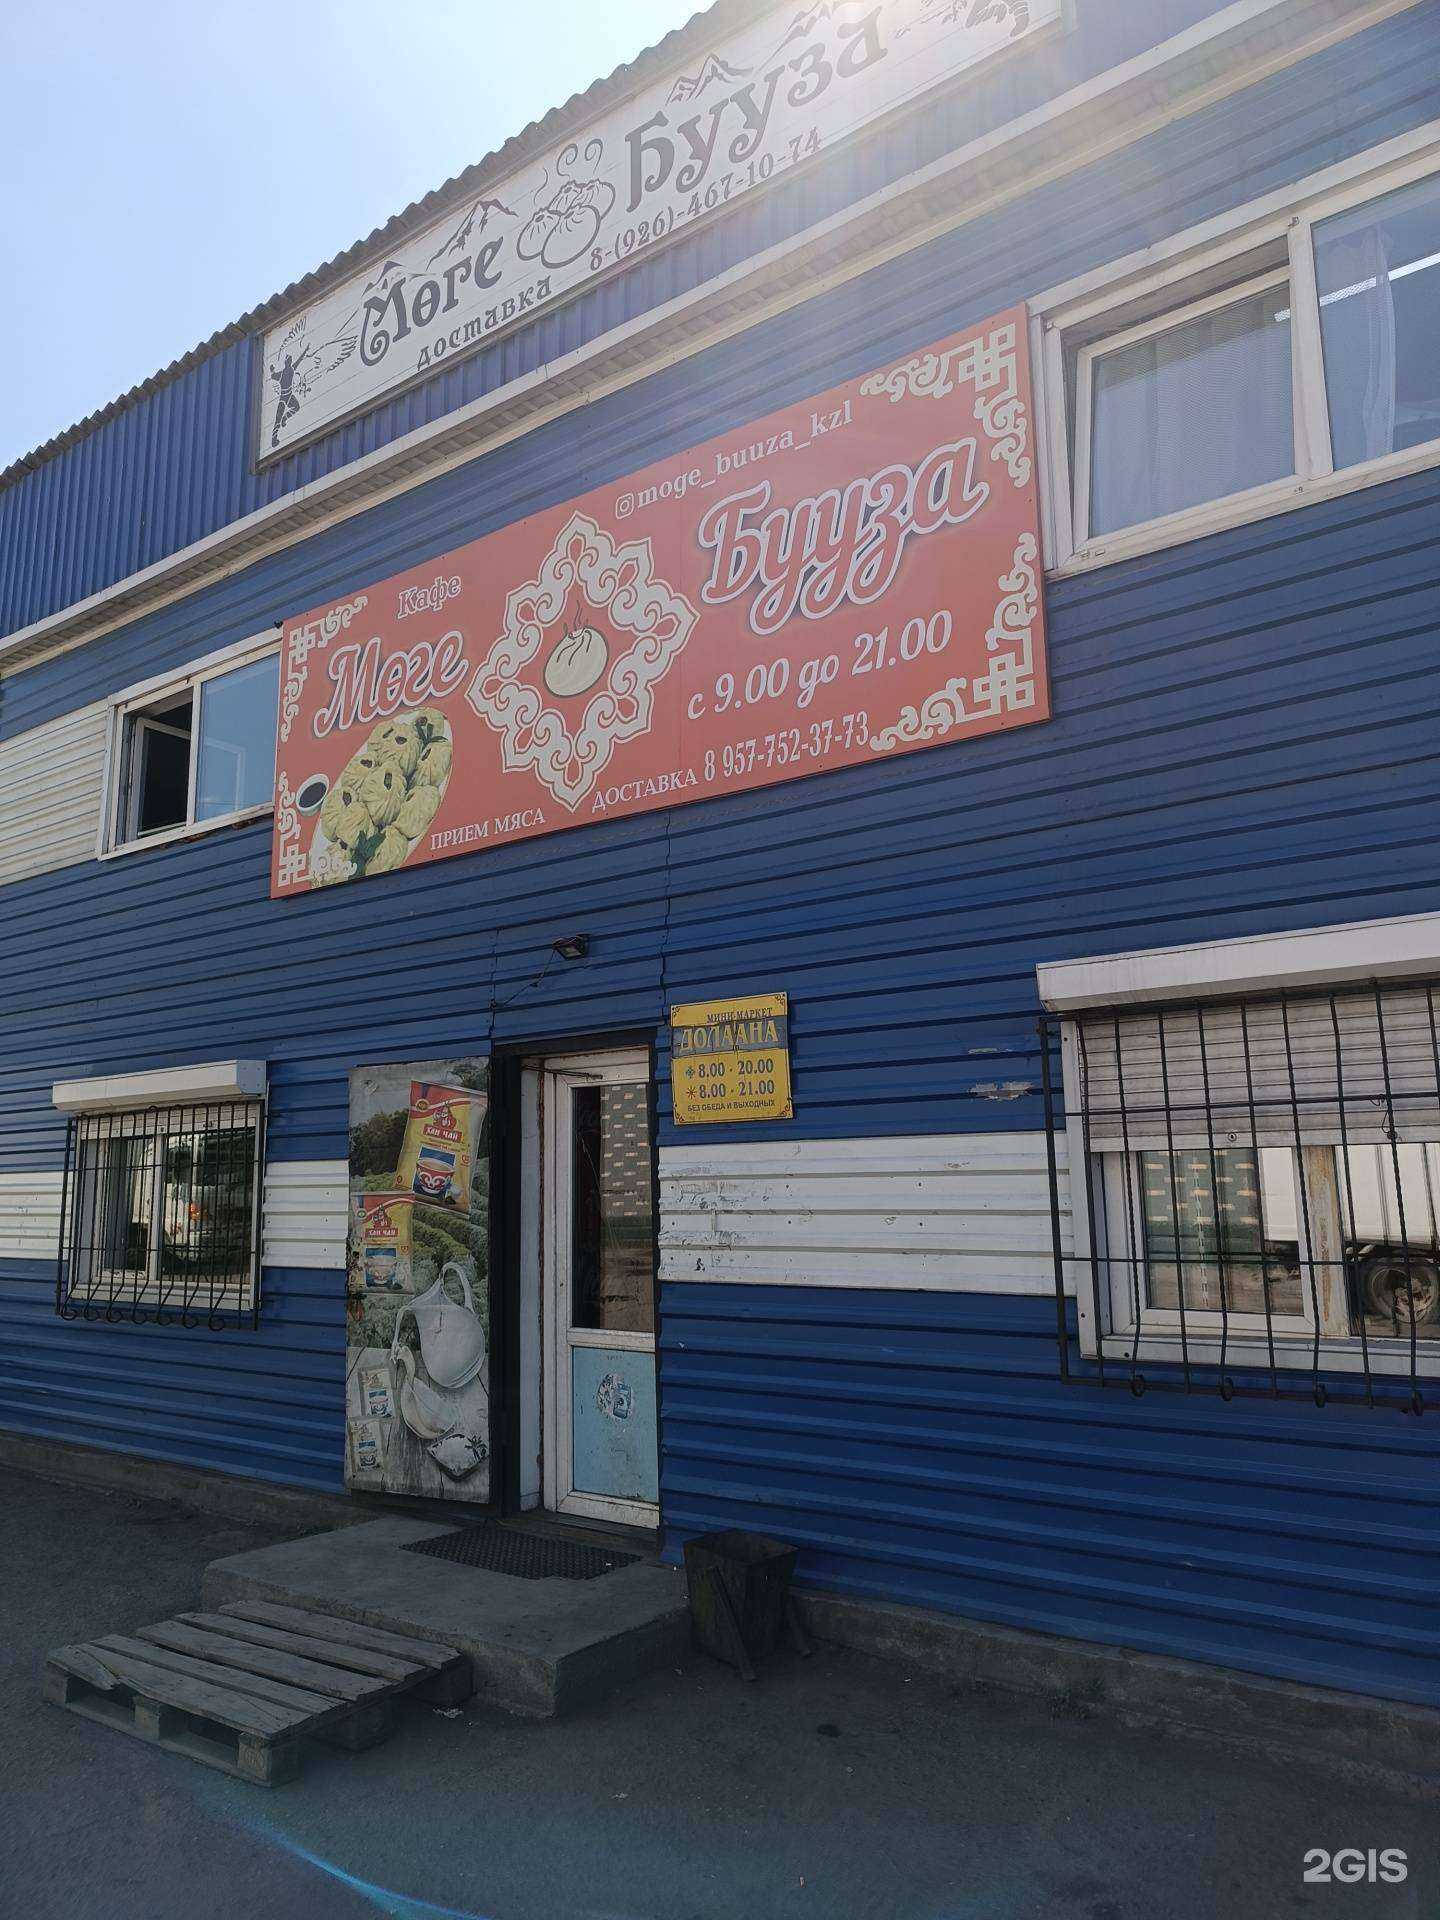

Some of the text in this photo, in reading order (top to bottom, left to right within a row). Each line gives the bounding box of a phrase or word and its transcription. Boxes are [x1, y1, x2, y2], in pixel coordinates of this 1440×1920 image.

[624, 8, 889, 212] Бууза
[590, 126, 822, 271] 8-(926)-467-10-74
[637, 400, 853, 508] moge_buuza_kzl
[698, 436, 990, 635] Бууза
[398, 576, 462, 619] Кафе
[714, 657, 790, 713] 9.00
[796, 654, 840, 708] до
[851, 609, 952, 676] 21.00
[591, 710, 870, 814] ДОСТАВКА 8 957-752-37-73
[430, 807, 547, 850] ПРИЕМ МЯСА
[681, 1020, 778, 1051] ДОЛААНА
[698, 1062, 726, 1079] 8.00
[738, 1058, 774, 1075] 20.00
[687, 1103, 701, 1112] БЕЗ
[702, 1101, 726, 1111] ОБЕДА
[733, 1098, 776, 1109] ВЫХОДНЫХ
[699, 1082, 728, 1100] 8.00
[738, 1079, 776, 1097] 21.00
